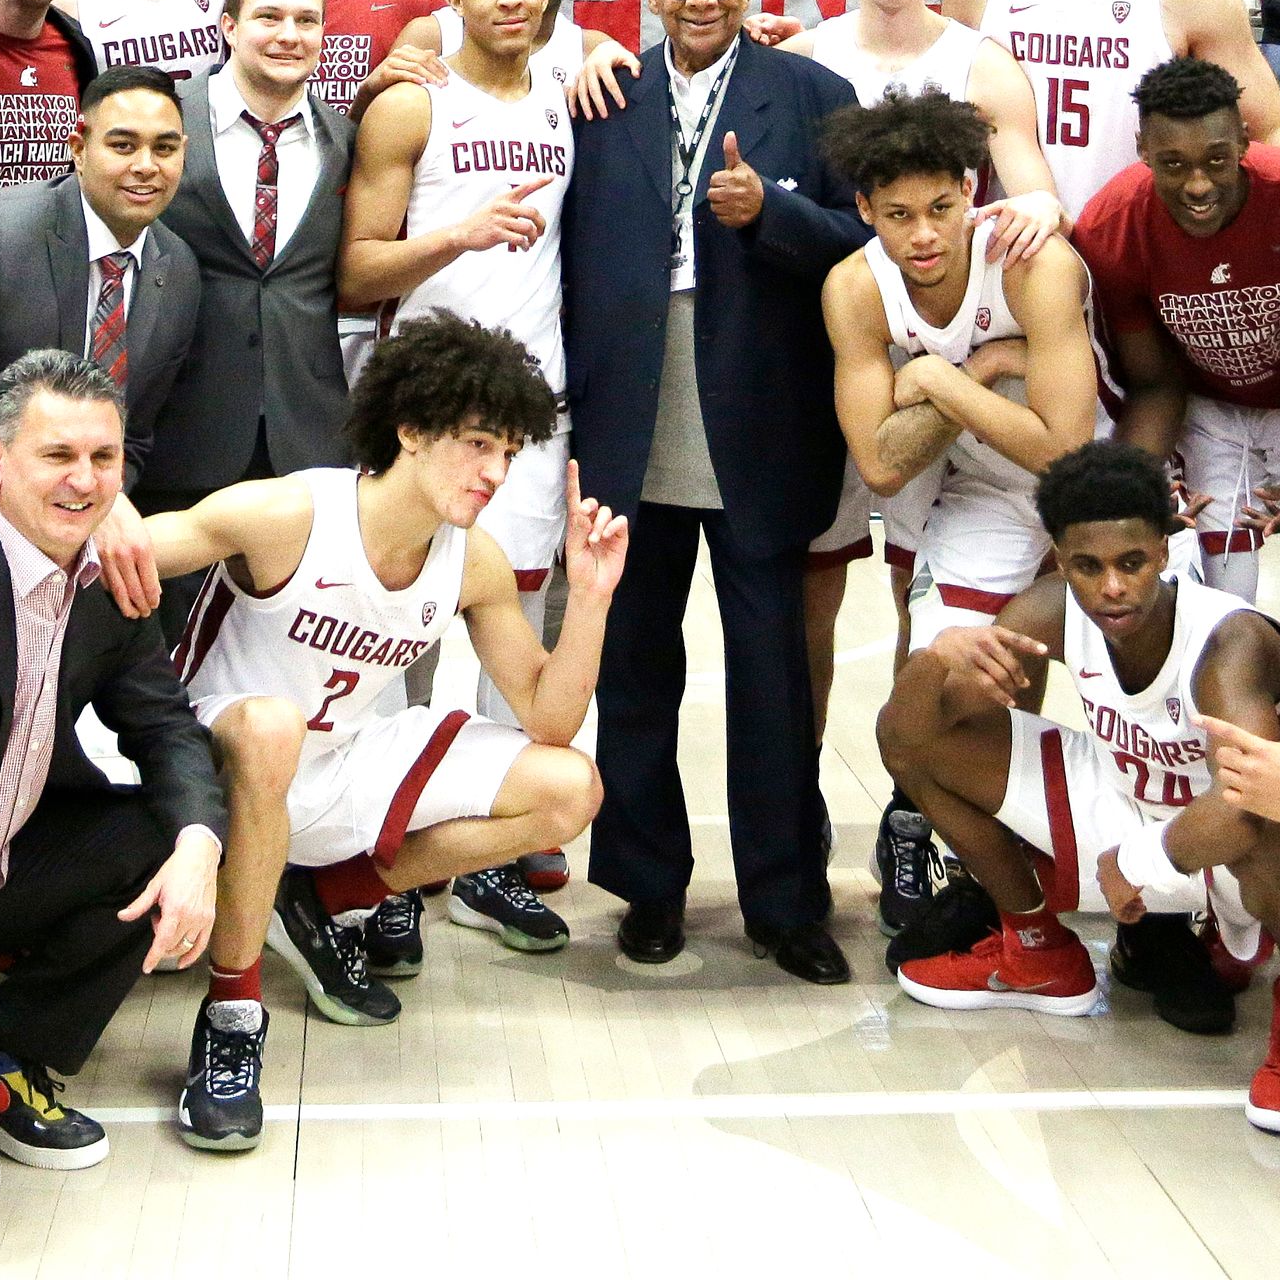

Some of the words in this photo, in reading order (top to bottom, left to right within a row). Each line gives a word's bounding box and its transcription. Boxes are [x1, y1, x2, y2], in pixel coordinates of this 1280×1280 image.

[102, 25, 219, 68] COUGARS
[323, 50, 369, 64] YOU
[324, 35, 370, 50] YOU
[1009, 31, 1129, 69] COUGARS
[322, 63, 369, 80] YOU
[1046, 77, 1090, 147] 15
[451, 140, 566, 176] COUGARS
[1159, 290, 1240, 310] THANK
[1161, 304, 1246, 324] THANK
[288, 607, 429, 667] COUGARS
[307, 666, 360, 732] 2
[1080, 695, 1207, 767] COUGARS
